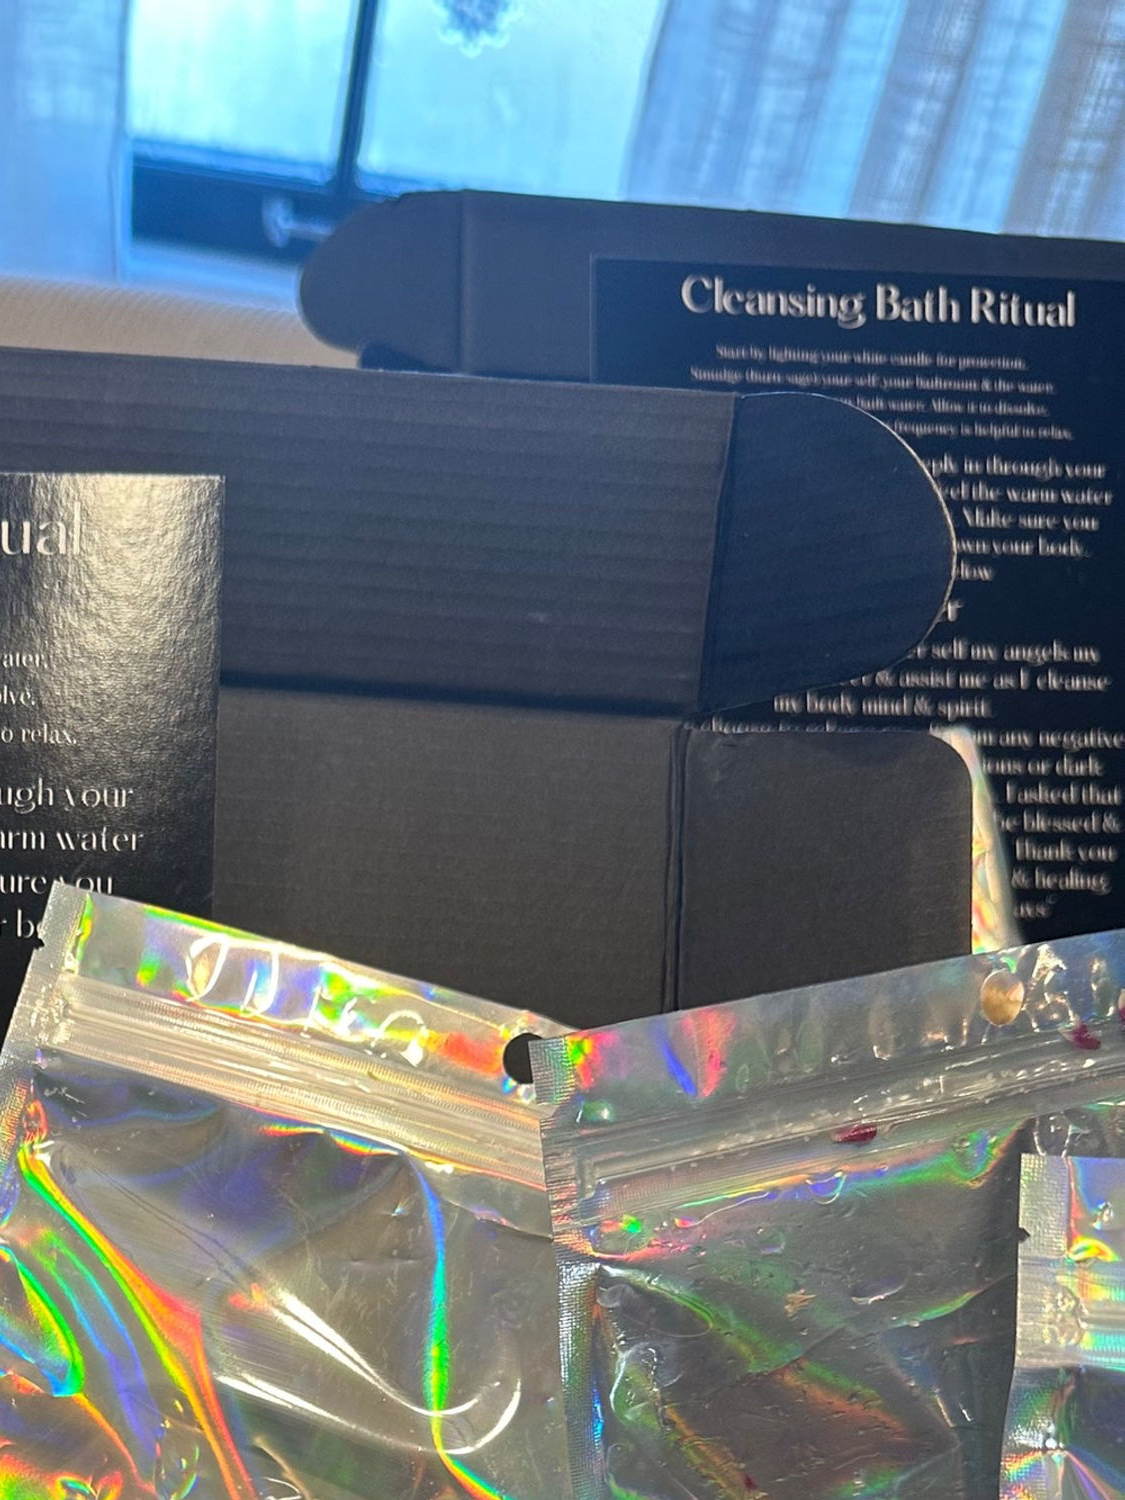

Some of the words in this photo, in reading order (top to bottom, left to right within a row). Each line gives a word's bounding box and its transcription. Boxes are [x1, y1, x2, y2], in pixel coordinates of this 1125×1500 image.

[681, 273, 866, 329] Cleansing
[876, 283, 960, 323] Bath
[971, 286, 1075, 327] Ritual
[63, 784, 133, 811] your
[56, 827, 143, 852] water
